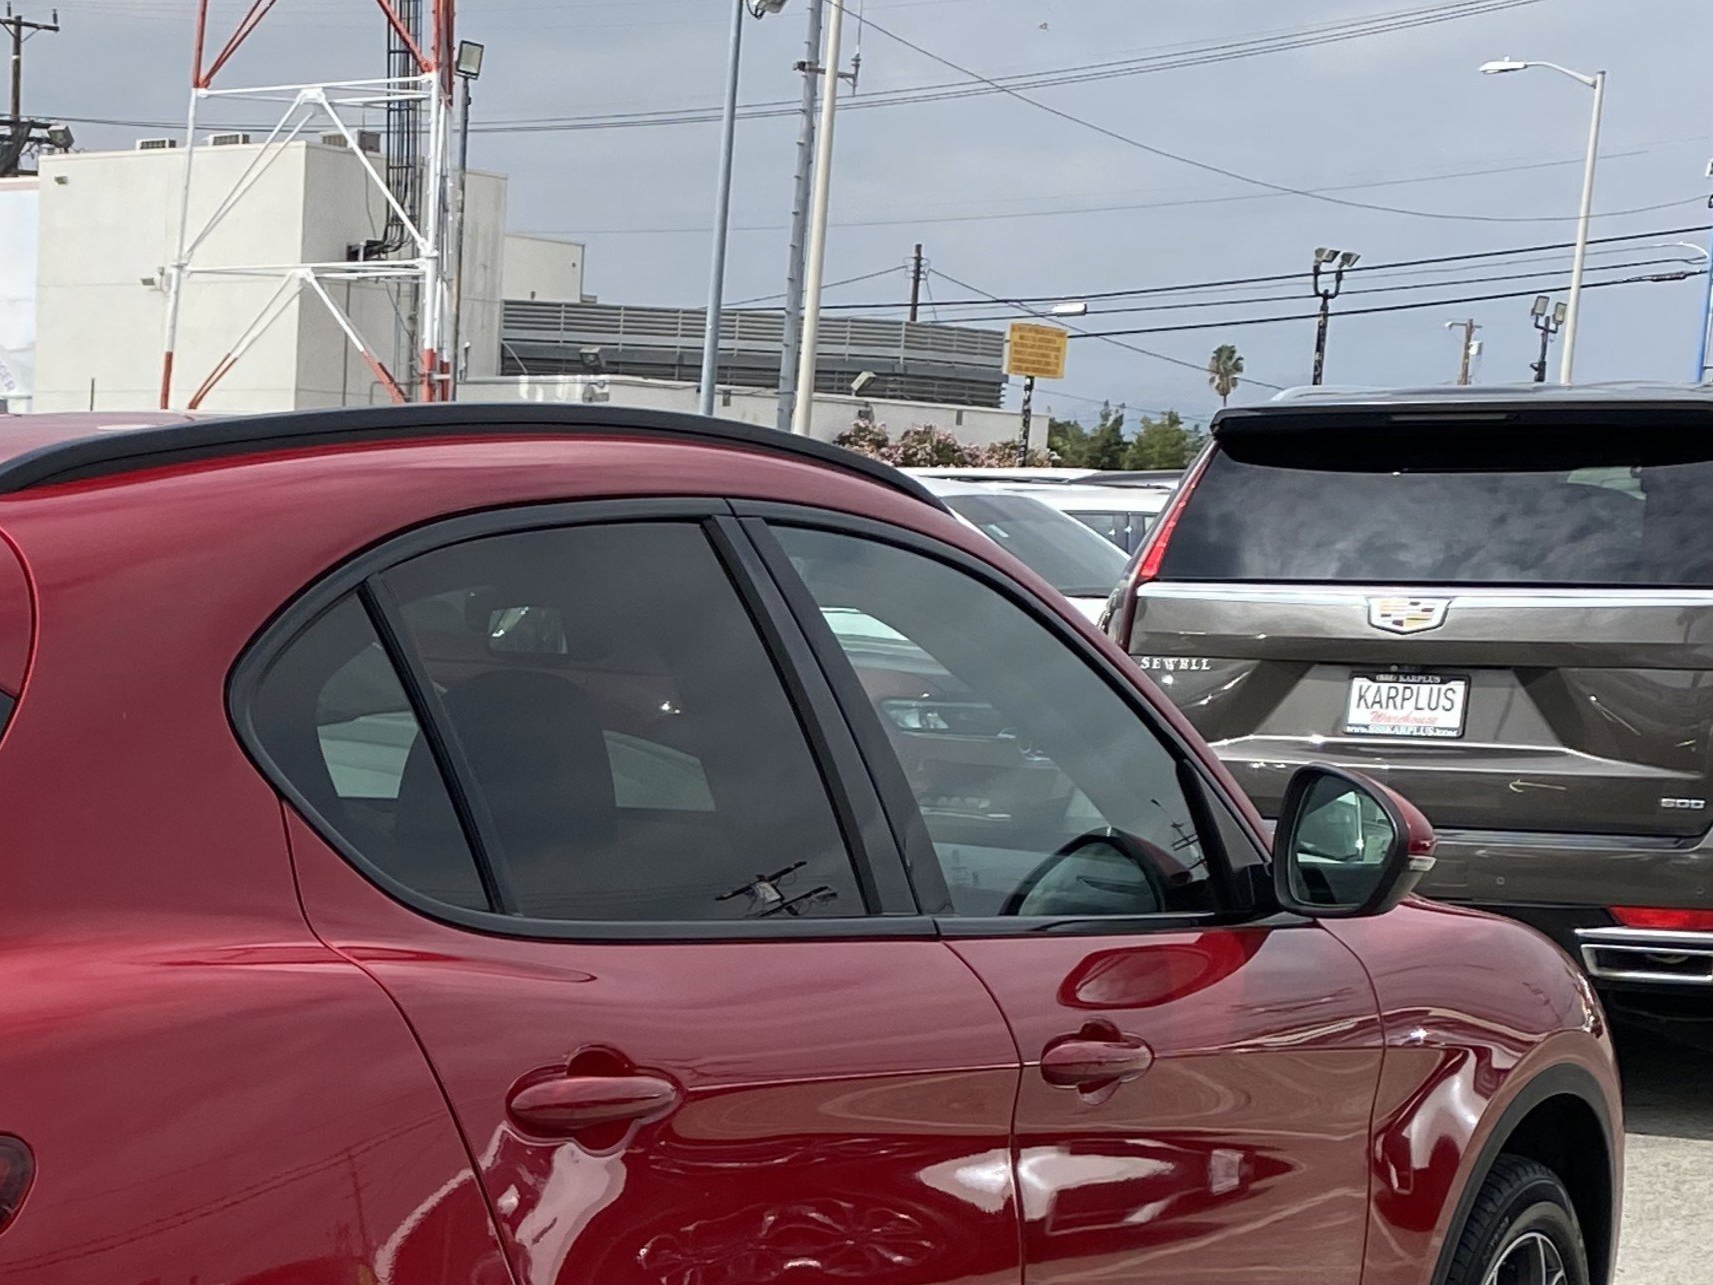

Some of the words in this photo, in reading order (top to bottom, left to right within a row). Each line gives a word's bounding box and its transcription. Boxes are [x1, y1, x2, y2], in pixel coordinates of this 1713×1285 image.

[1140, 656, 1211, 671] SEWELL
[1399, 673, 1441, 683] KARPLUS
[1357, 685, 1456, 711] KARPLUS
[1369, 710, 1438, 725] Warehouse
